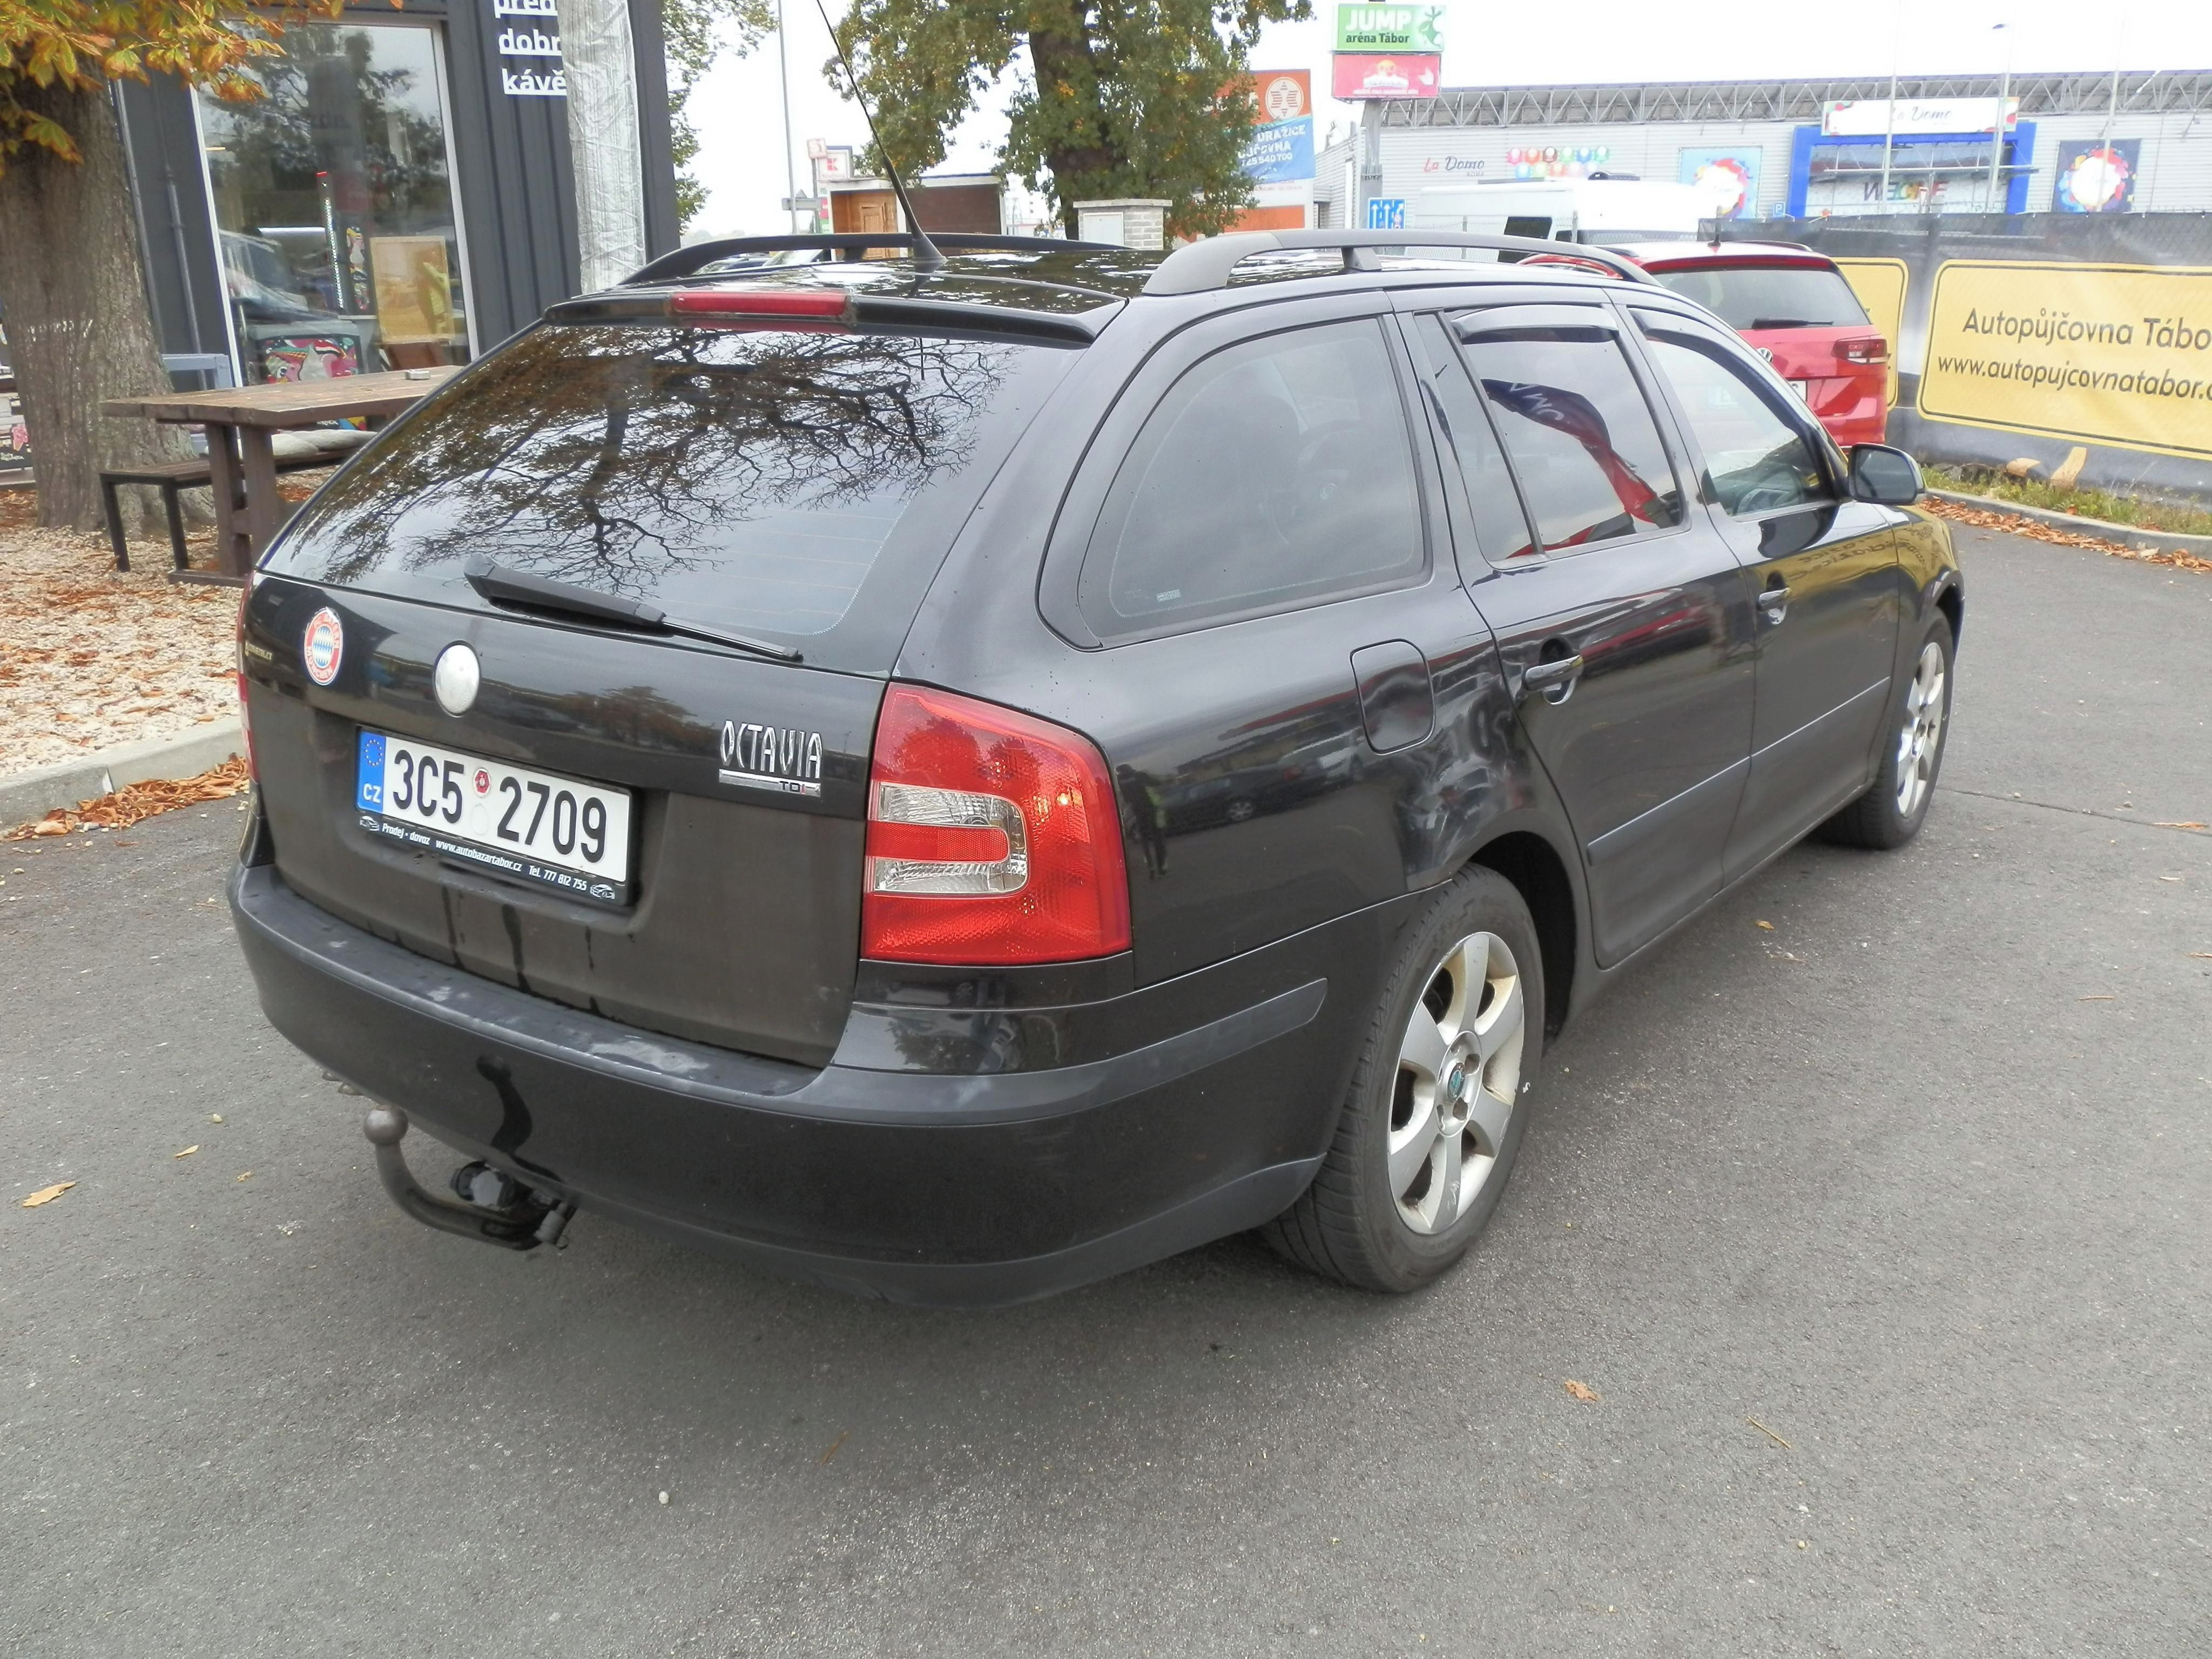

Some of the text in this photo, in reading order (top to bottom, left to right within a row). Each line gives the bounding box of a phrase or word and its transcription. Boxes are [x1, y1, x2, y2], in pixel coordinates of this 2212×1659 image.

[1345, 9, 1412, 31] JUMP
[1346, 31, 1410, 43] aréna Tábor
[502, 68, 566, 93] kávě
[1278, 152, 1293, 161] 700
[1424, 155, 1485, 173] La Domo
[1963, 306, 2133, 346] Autopůjčovna
[719, 719, 824, 779] OCTAVIA
[362, 781, 381, 804] CZ
[392, 748, 608, 864] 3C5 2709
[382, 822, 587, 891] Prodej dovoz www.autobazartabor.cz Tel. 777 812 755
